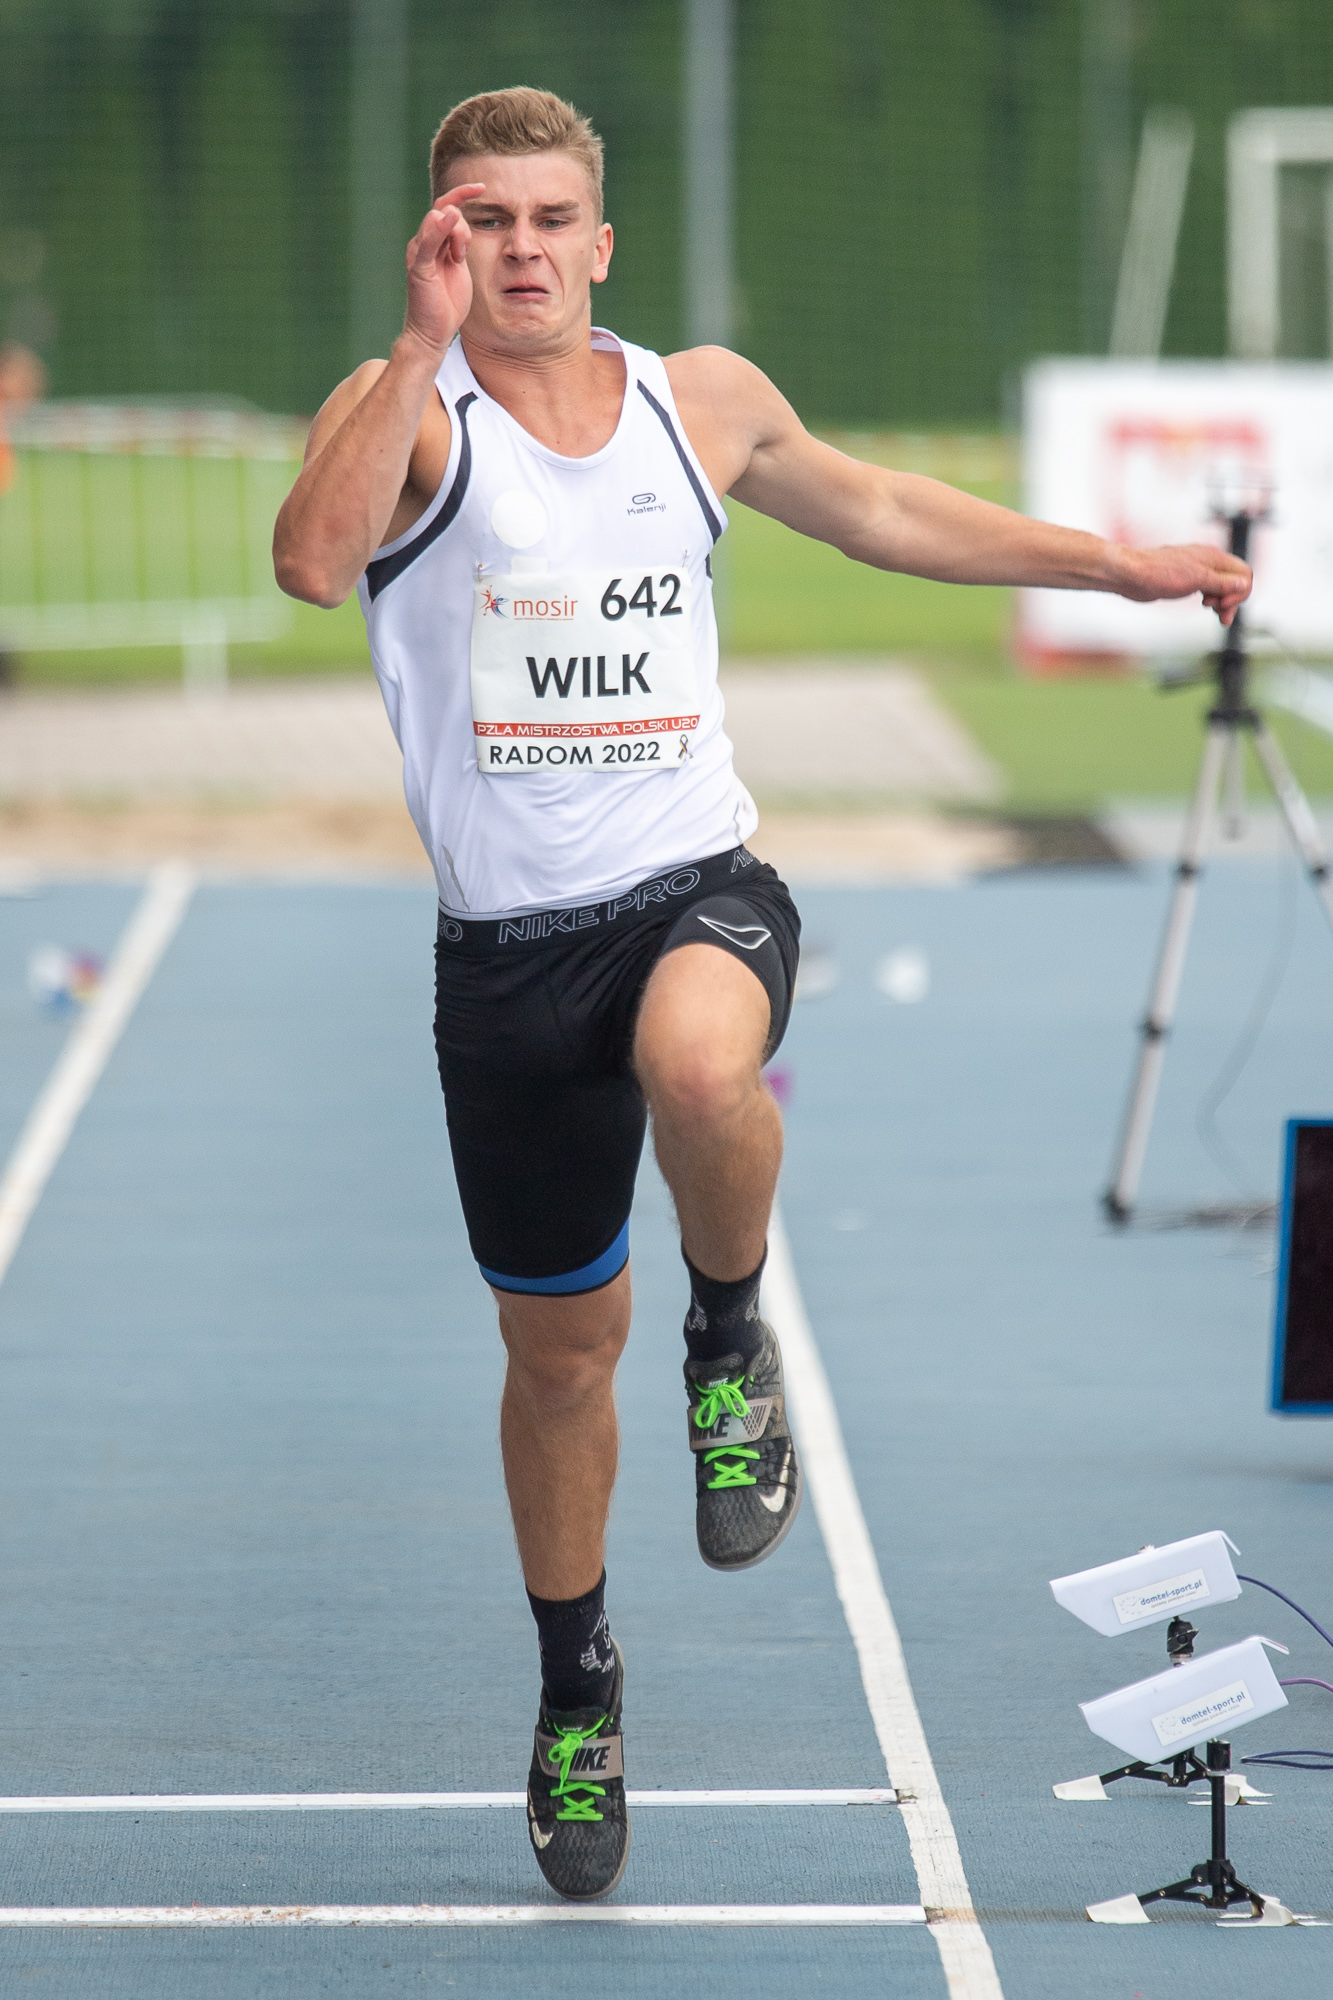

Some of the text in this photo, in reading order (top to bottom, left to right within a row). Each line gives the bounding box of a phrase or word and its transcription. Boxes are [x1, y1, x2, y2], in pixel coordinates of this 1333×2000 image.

[626, 503, 667, 516] Kalenji
[513, 595, 578, 616] mosir
[600, 573, 683, 622] 642
[525, 651, 652, 699] WILK
[477, 718, 698, 736] PZLA MISTRZOSTWA POLSKI U20
[490, 741, 661, 765] RADOM 2022
[498, 868, 700, 943] NIKE PRO
[1140, 1579, 1203, 1606] domtel-sport.pl
[1181, 1691, 1246, 1725] domtel-sport.pl
